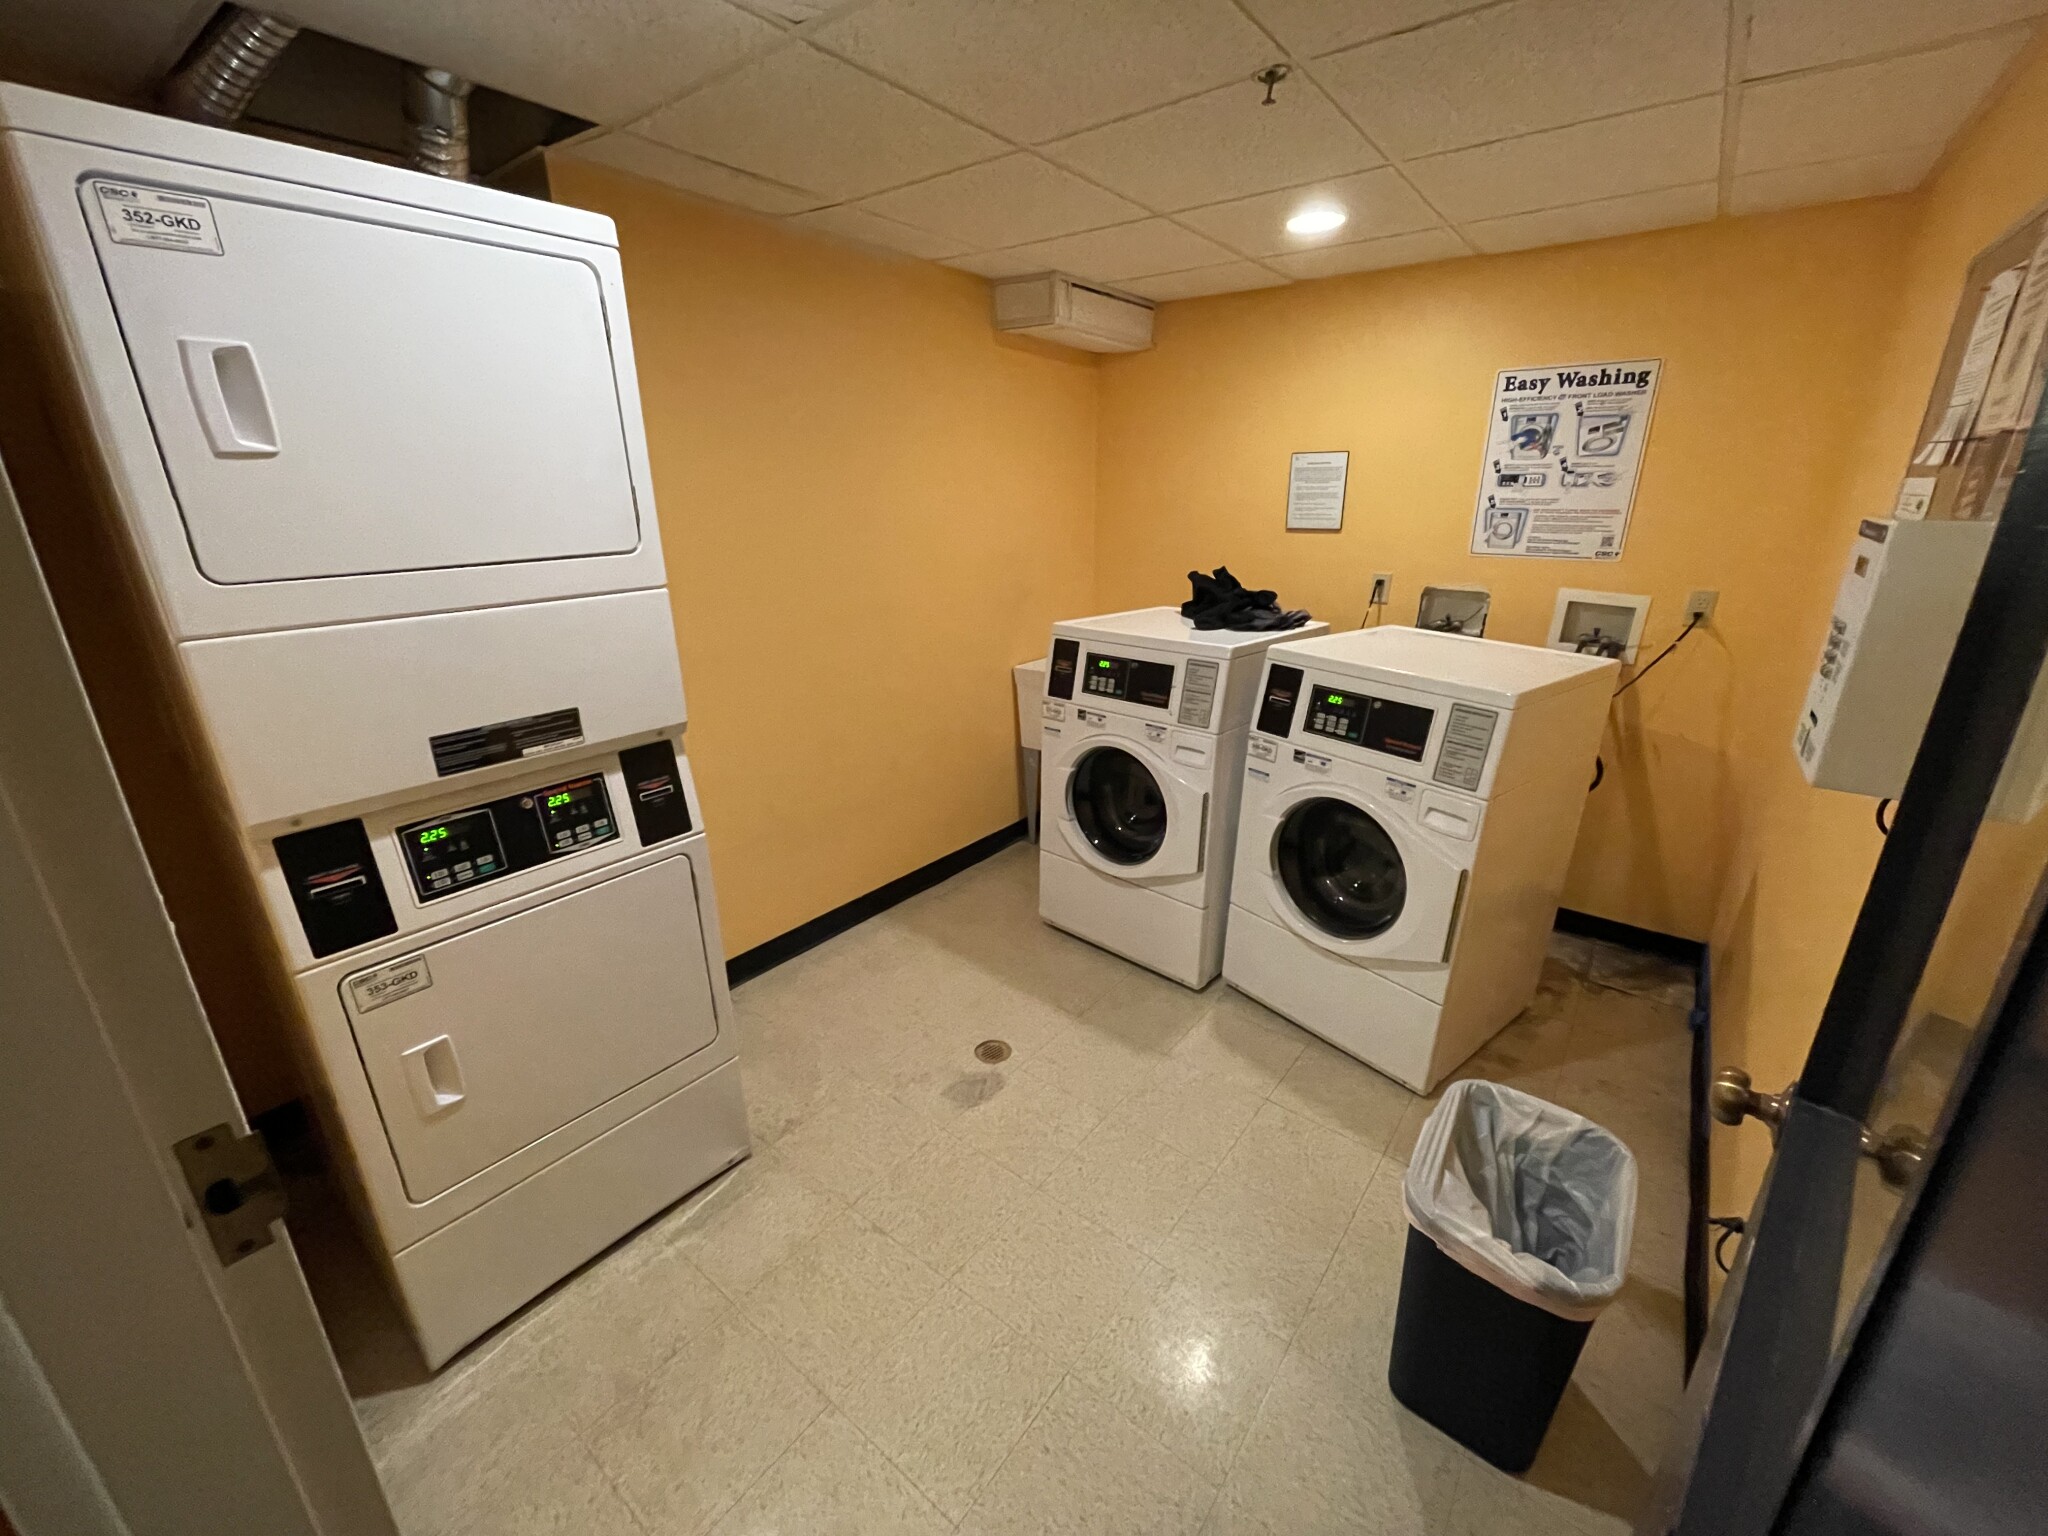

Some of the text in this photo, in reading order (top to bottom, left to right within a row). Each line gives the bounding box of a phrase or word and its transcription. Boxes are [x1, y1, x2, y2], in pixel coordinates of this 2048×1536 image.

[121, 208, 202, 231] 352-GKD
[1503, 368, 1652, 395] Easy Washing
